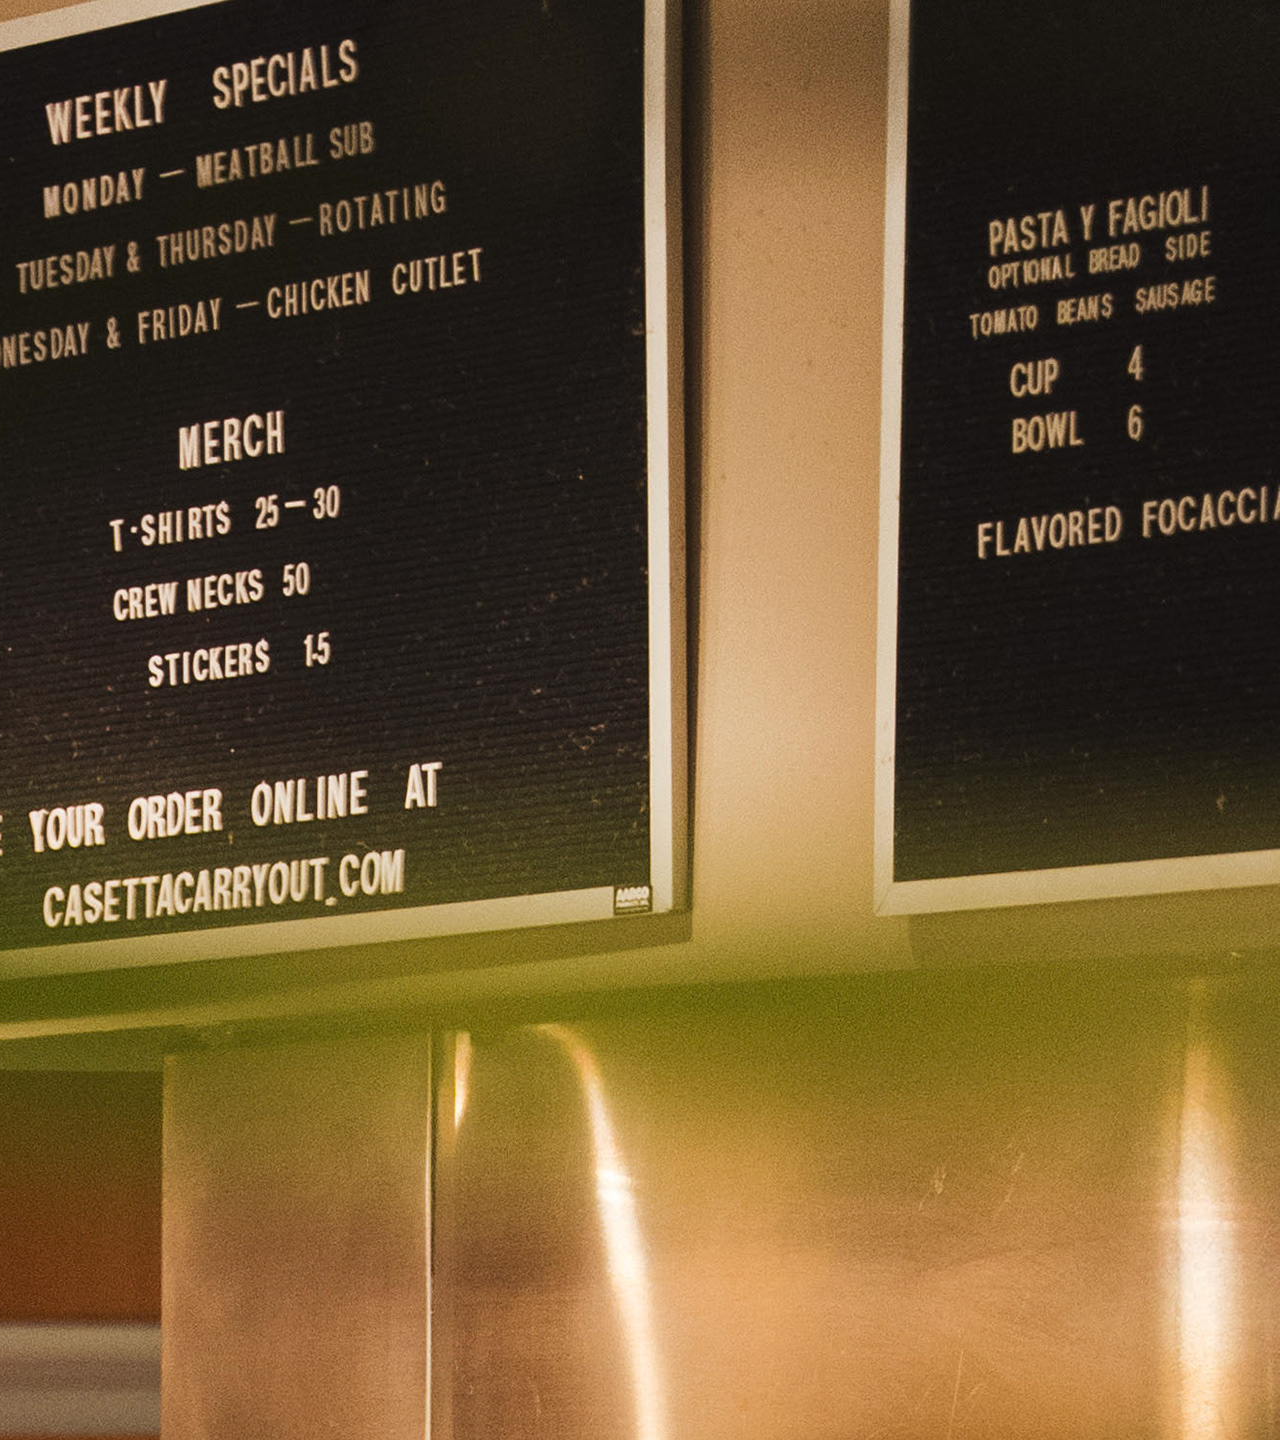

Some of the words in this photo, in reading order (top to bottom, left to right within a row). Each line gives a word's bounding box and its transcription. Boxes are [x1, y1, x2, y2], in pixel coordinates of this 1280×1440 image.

[45, 79, 167, 146] WEEKLY
[212, 39, 357, 110] SPECIALS
[43, 167, 145, 219] MONDAY
[195, 133, 319, 188] MEATBALL
[329, 120, 375, 159] SUB
[15, 245, 115, 294] TUESDAY
[126, 241, 140, 273] &
[155, 213, 276, 268] THURSDAY
[319, 180, 446, 237] ROTATING
[988, 209, 1069, 257] PASTA
[1080, 204, 1095, 241] Y
[1108, 185, 1208, 237] FAGIOLI
[987, 254, 1075, 290] OPTIONAL
[1088, 242, 1141, 275] BREAD
[1164, 230, 1211, 262] SIDE
[106, 316, 121, 350] &
[137, 297, 221, 345] FRIDAY
[266, 269, 370, 319] CHICKEN
[391, 247, 482, 296] CUTLET
[969, 304, 1039, 339] TOMATO
[1056, 292, 1113, 325] BEANS
[1134, 276, 1215, 314] SAUSAGE
[1009, 357, 1059, 398] CUP
[1127, 345, 1144, 381] 4
[178, 410, 284, 470] MERCH
[1011, 410, 1084, 454] BOWL
[1127, 404, 1143, 441] 6
[977, 505, 1123, 559] FLAVORED
[112, 581, 179, 621] CREW
[186, 568, 264, 612] NECKS
[282, 561, 310, 597] 50
[147, 638, 271, 688] STICKERS
[28, 802, 106, 853] YOUR
[127, 788, 223, 841] ORDER
[250, 770, 369, 827] ONLINE
[404, 761, 443, 810] AT
